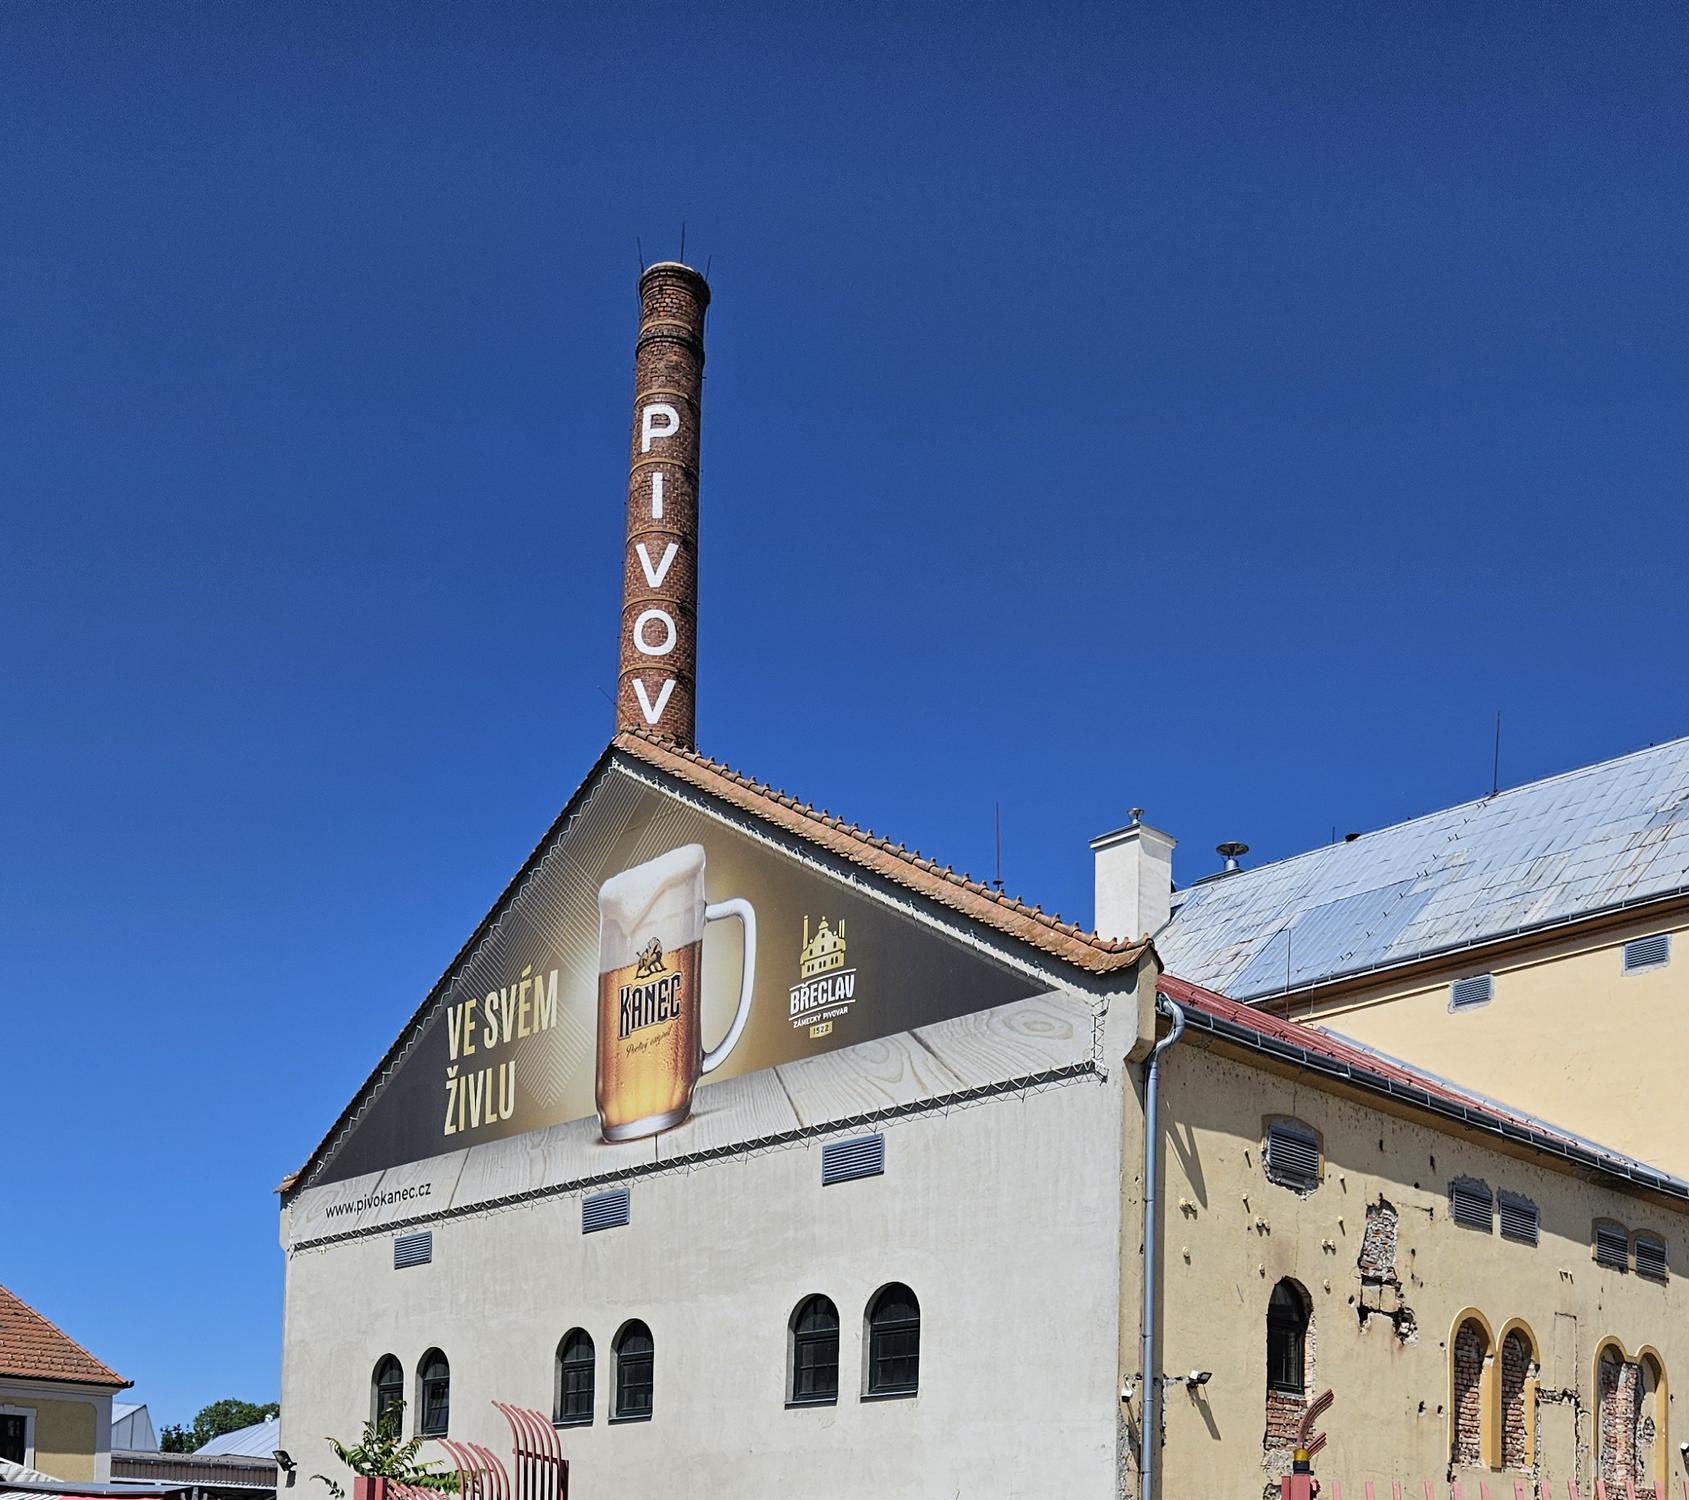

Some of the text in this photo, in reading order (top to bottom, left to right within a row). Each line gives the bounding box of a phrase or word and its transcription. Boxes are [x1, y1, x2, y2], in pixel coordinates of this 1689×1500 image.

[447, 964, 559, 1061] VE SVÉM
[618, 972, 682, 1040] KANEC
[790, 974, 855, 1015] BŘECLAV
[822, 1006, 849, 1020] PIVOVAR
[813, 1024, 829, 1036] 1522
[444, 1061, 516, 1136] ŽIVLU
[325, 1182, 432, 1220] www.pivokanec.cz
